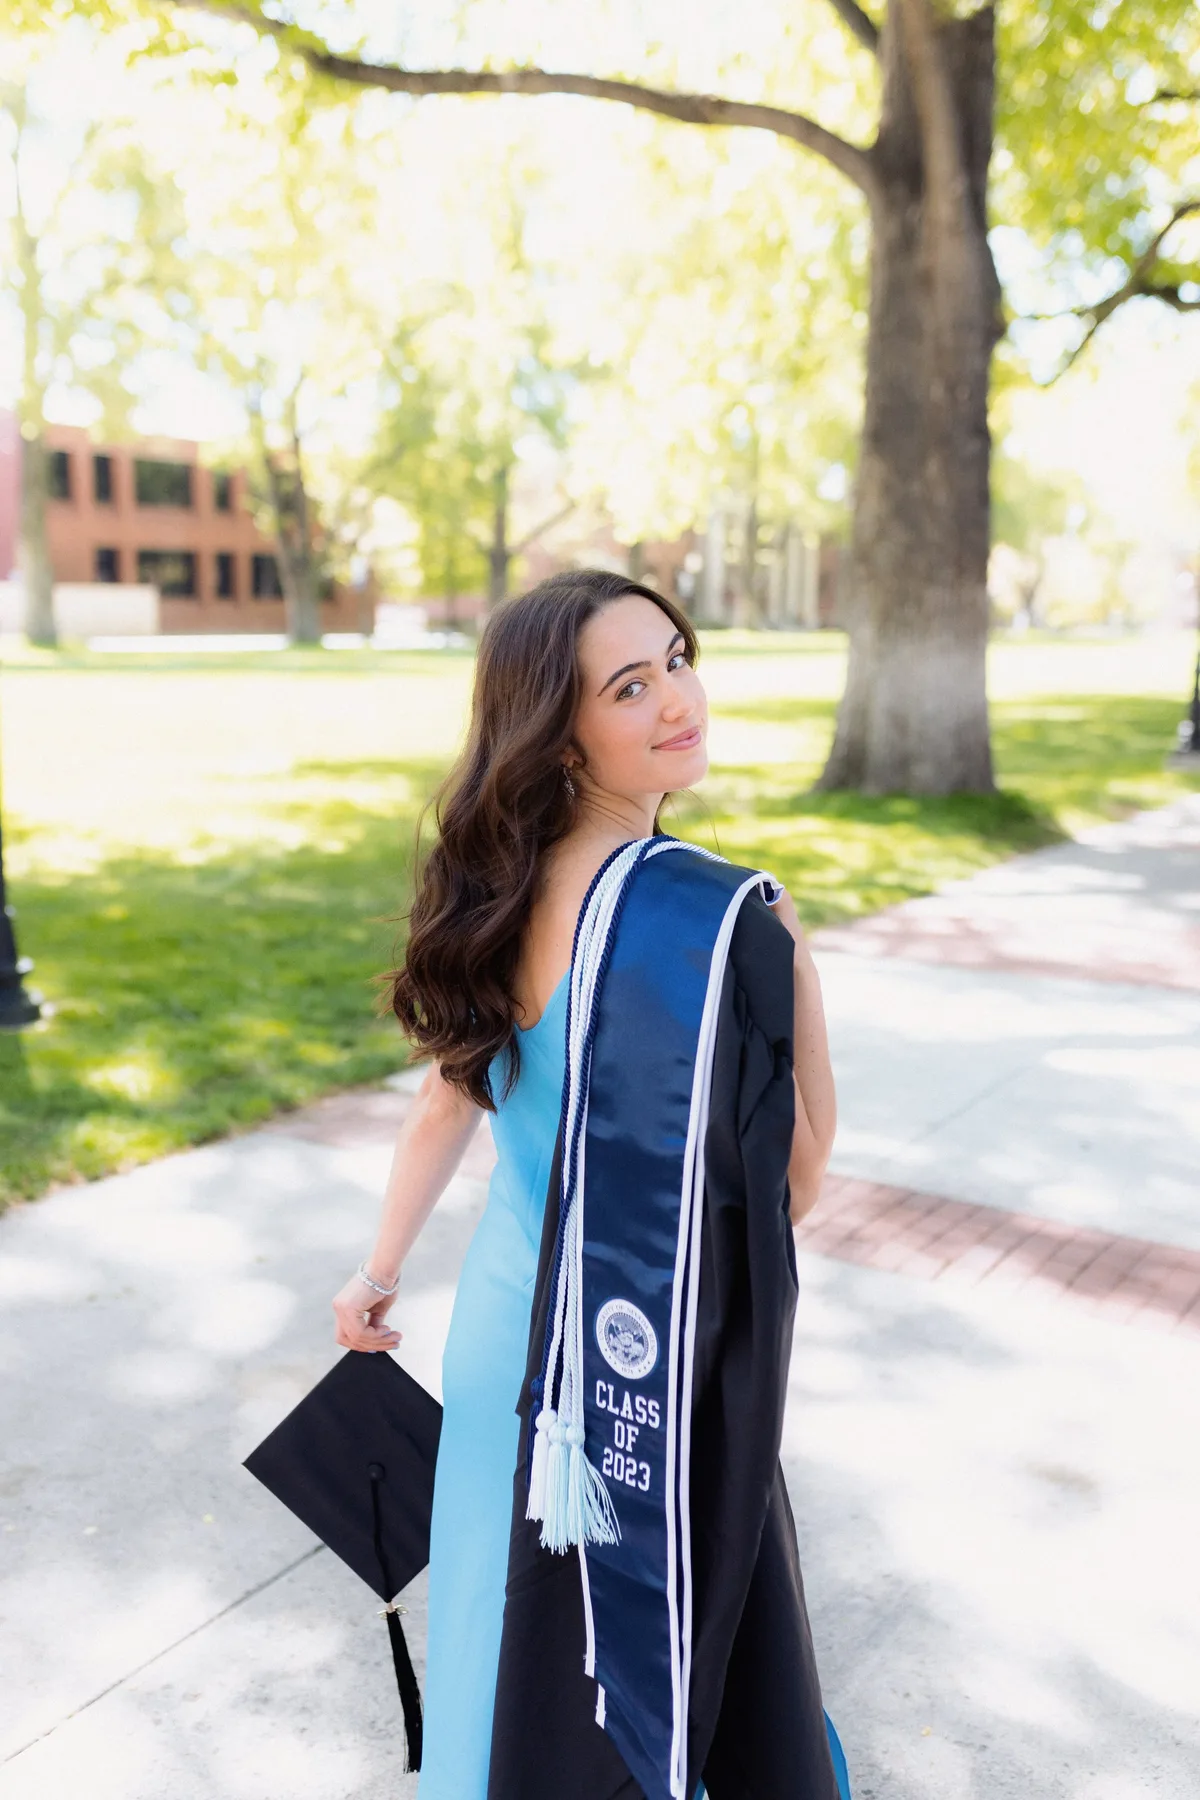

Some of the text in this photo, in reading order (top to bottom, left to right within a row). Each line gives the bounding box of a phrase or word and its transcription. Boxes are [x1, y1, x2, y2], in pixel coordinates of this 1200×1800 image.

[596, 1380, 660, 1428] CLASS
[614, 1420, 639, 1452] OF
[602, 1447, 650, 1491] 2023
